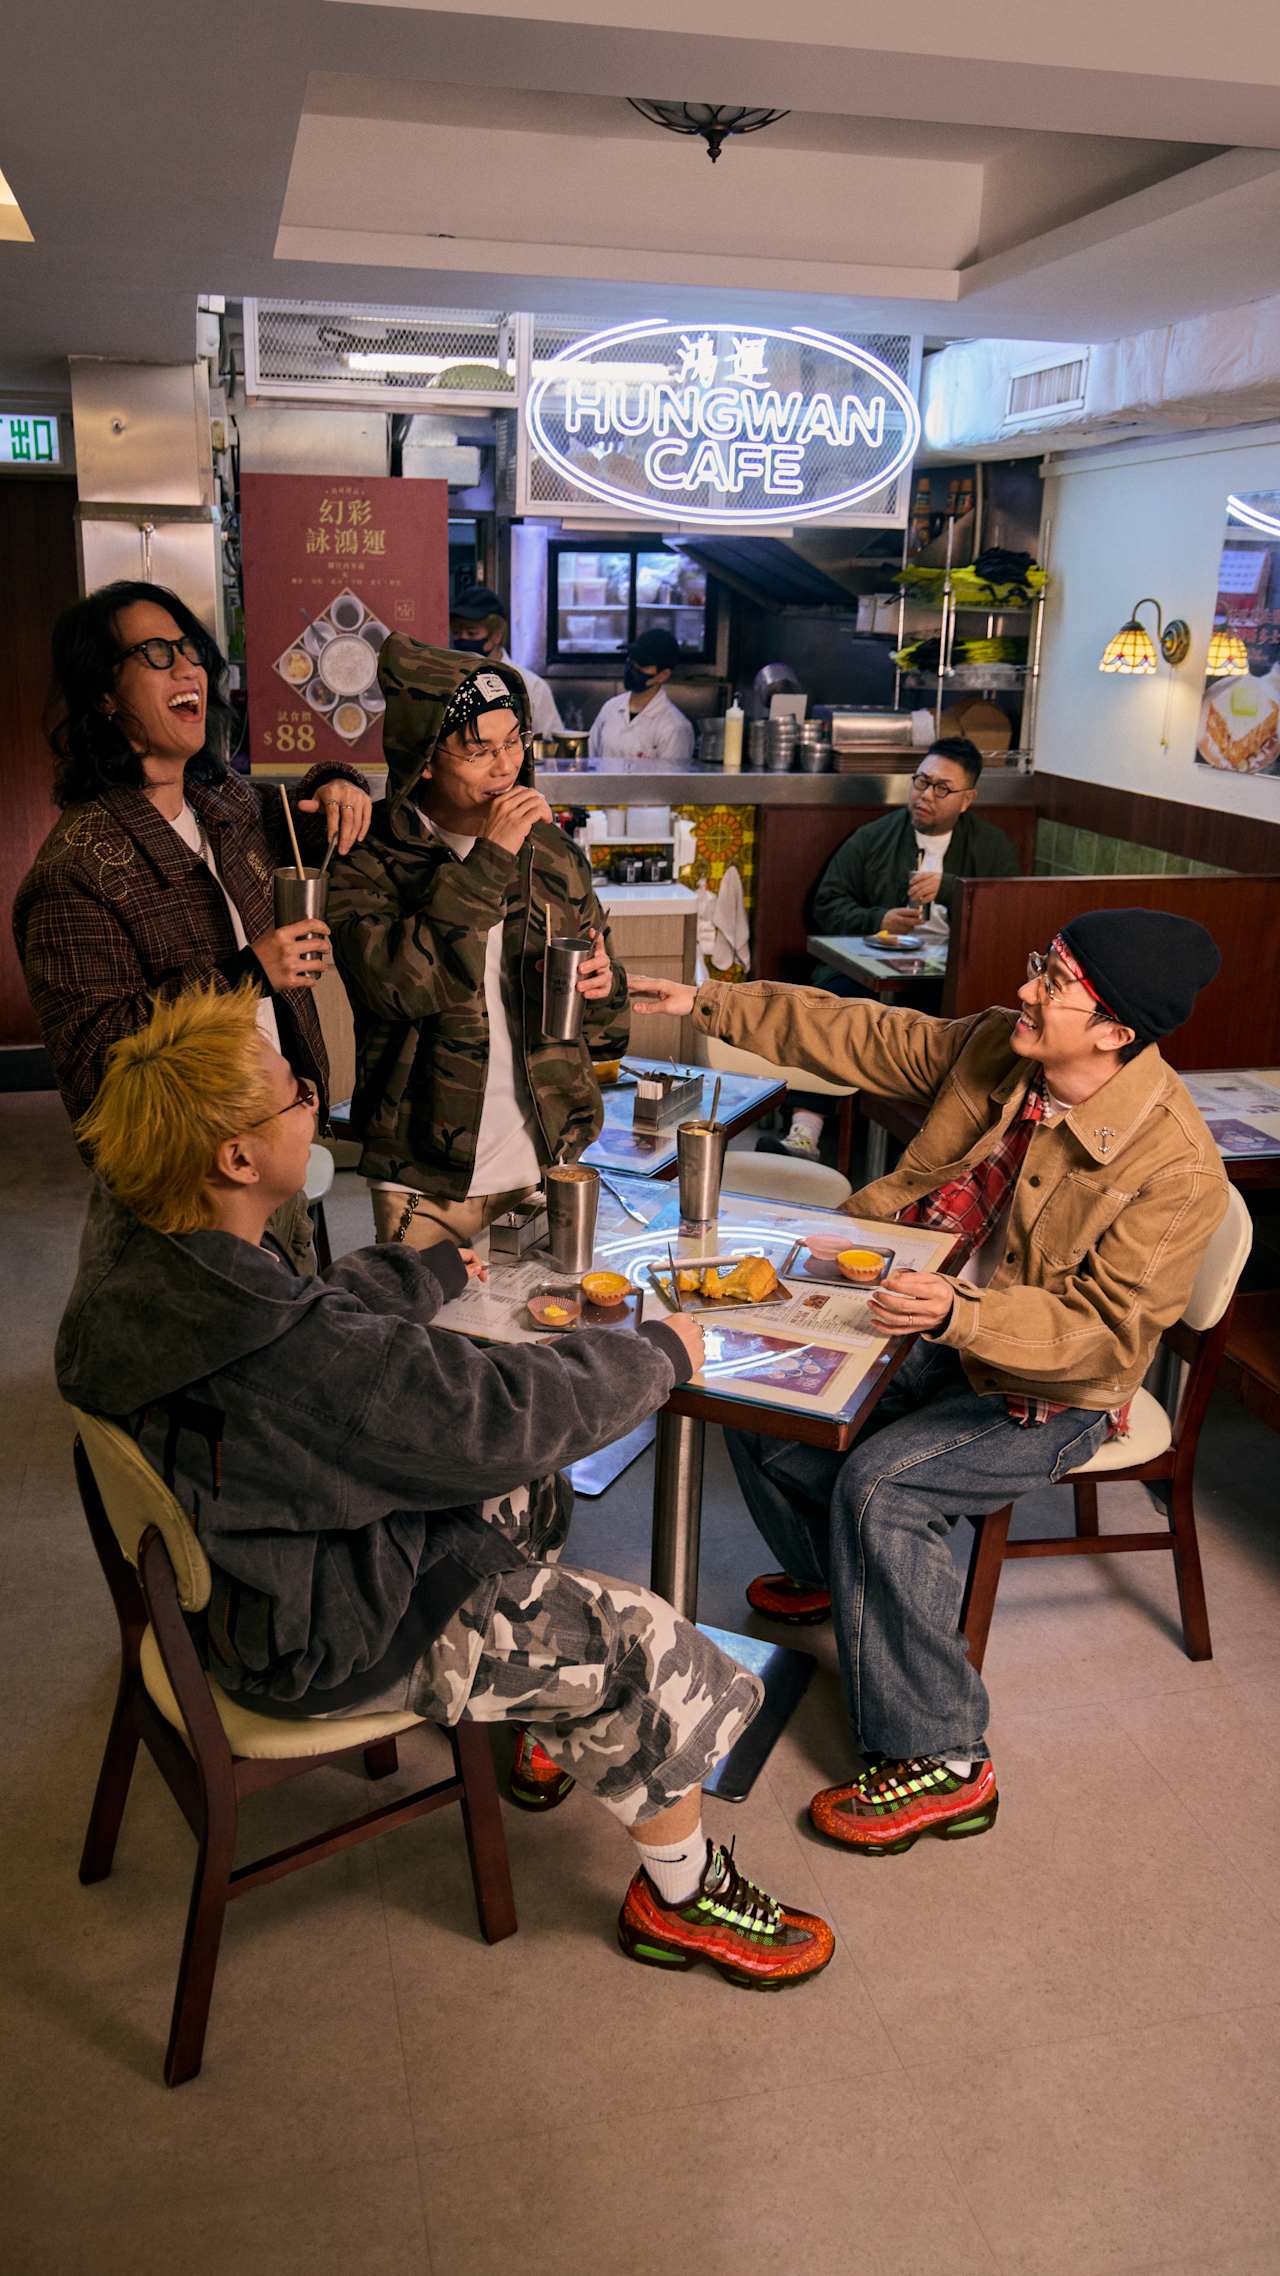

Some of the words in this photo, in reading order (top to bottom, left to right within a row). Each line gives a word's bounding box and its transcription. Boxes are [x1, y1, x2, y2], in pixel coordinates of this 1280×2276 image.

[674, 332, 772, 389] 鴻運
[564, 381, 886, 448] HUNGWAN
[10, 418, 53, 461] 出口
[644, 438, 806, 496] CAFE
[319, 498, 373, 526] 幻彩
[305, 527, 386, 556] 詠鴻運
[263, 724, 316, 753] $88
